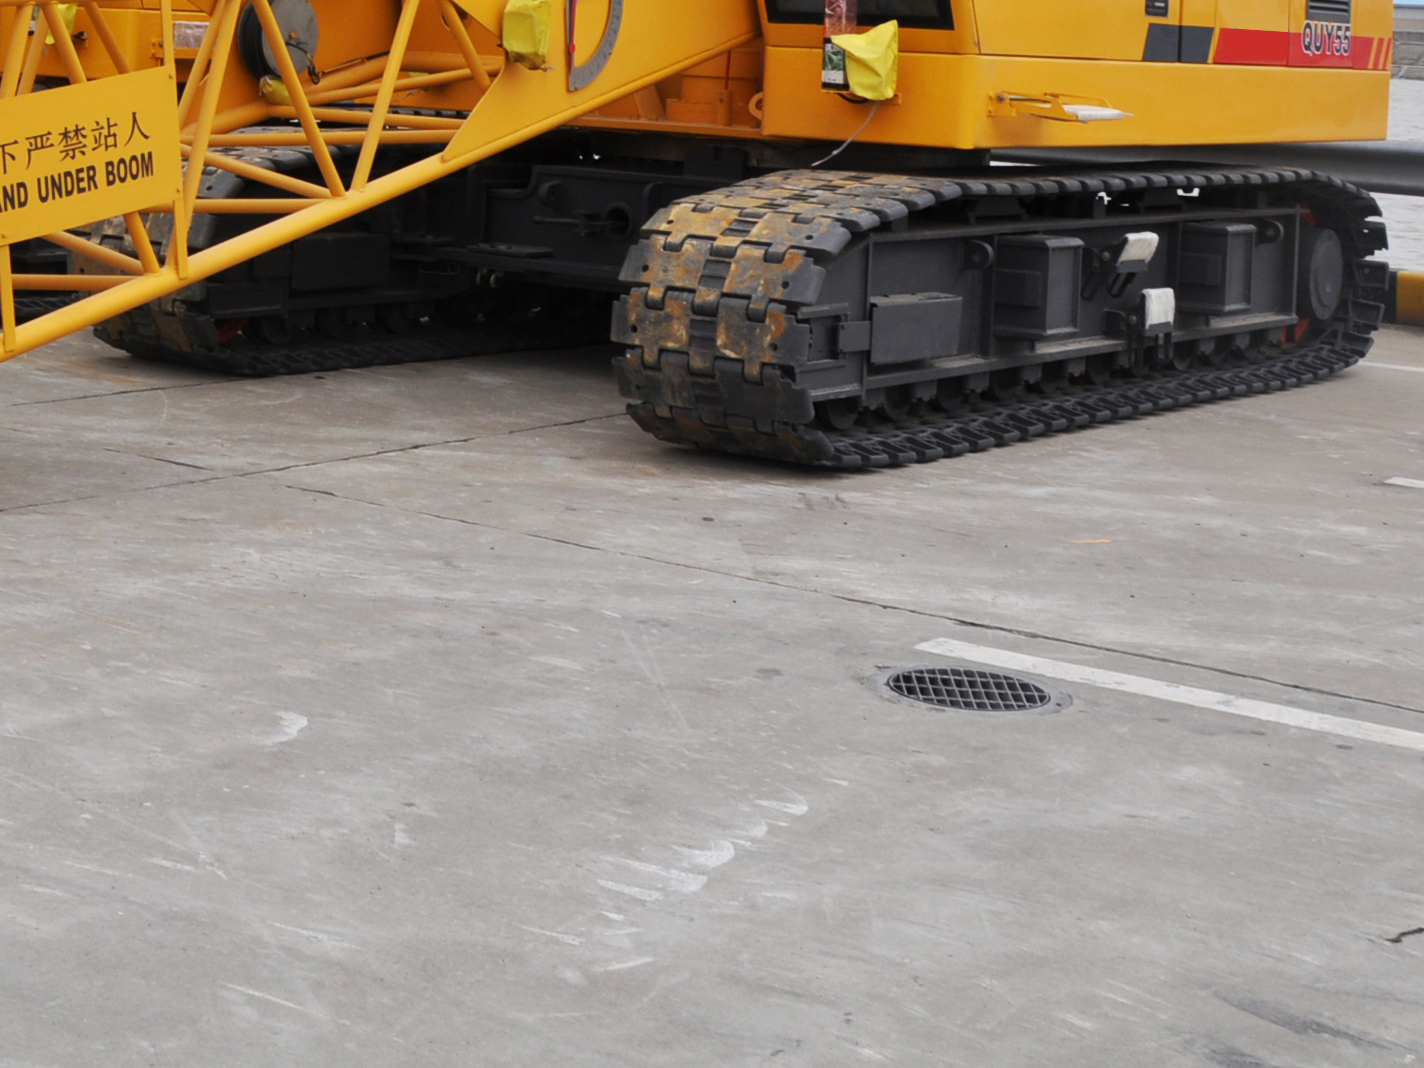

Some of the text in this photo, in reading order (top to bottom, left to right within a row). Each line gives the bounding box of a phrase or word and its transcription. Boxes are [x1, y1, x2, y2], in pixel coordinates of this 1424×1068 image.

[1302, 20, 1351, 56] QUY55
[37, 165, 98, 204] UNDER
[105, 151, 154, 187] BOOM
